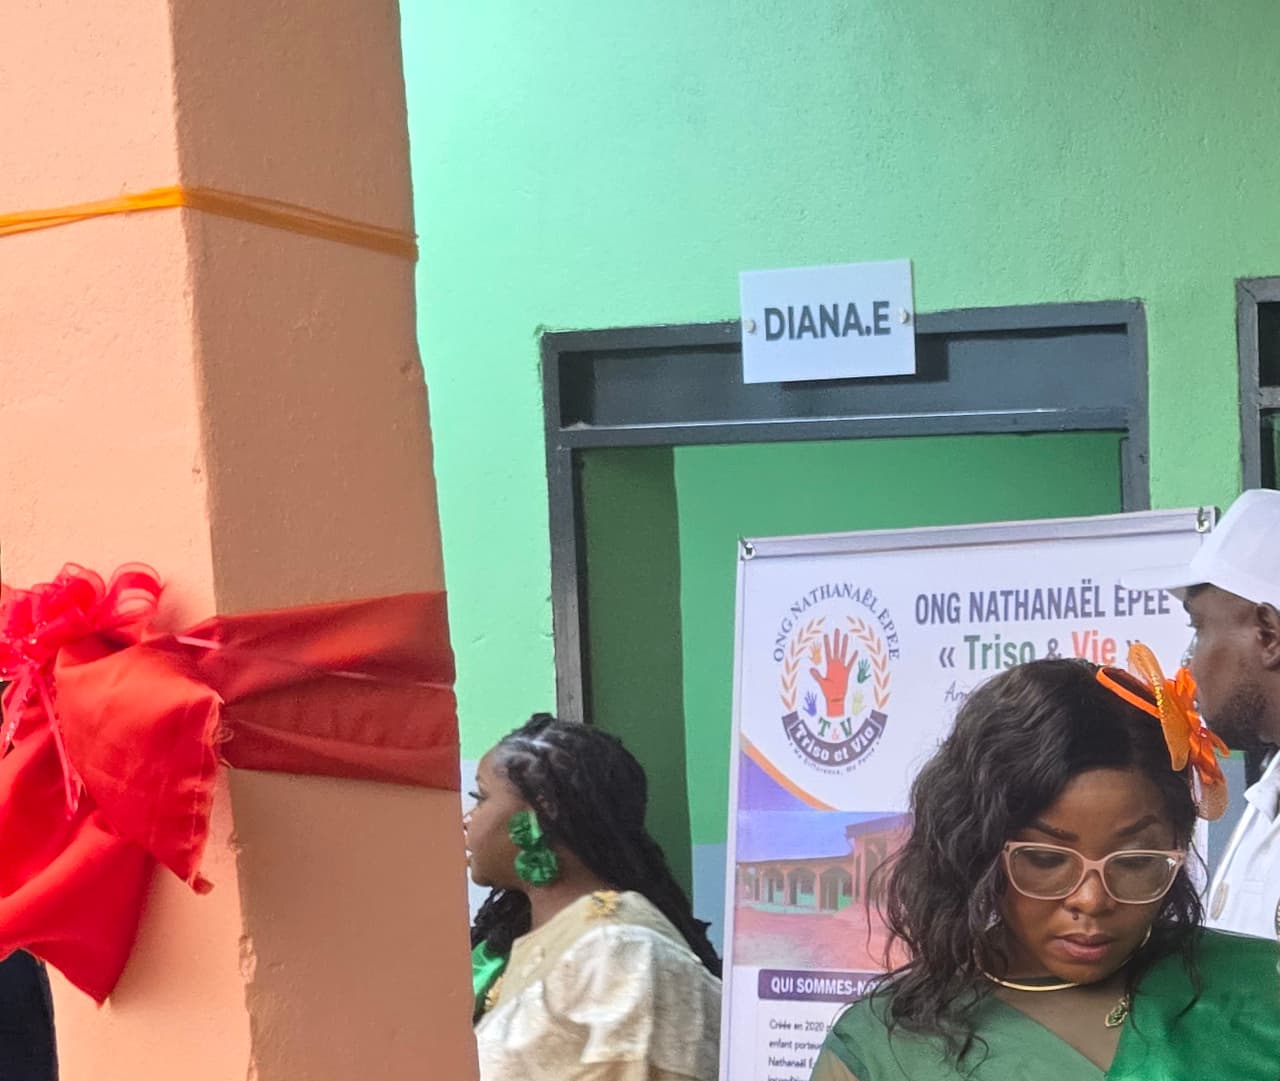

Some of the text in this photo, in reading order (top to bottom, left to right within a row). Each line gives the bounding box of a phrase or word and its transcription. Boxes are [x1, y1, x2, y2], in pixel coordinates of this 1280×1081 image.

[764, 300, 891, 342] DIANA.E
[915, 592, 961, 625] ONG
[969, 579, 1106, 623] NATHANAËL
[963, 633, 1036, 670] Triso
[1071, 630, 1117, 666] Vie
[771, 976, 793, 994] QUI
